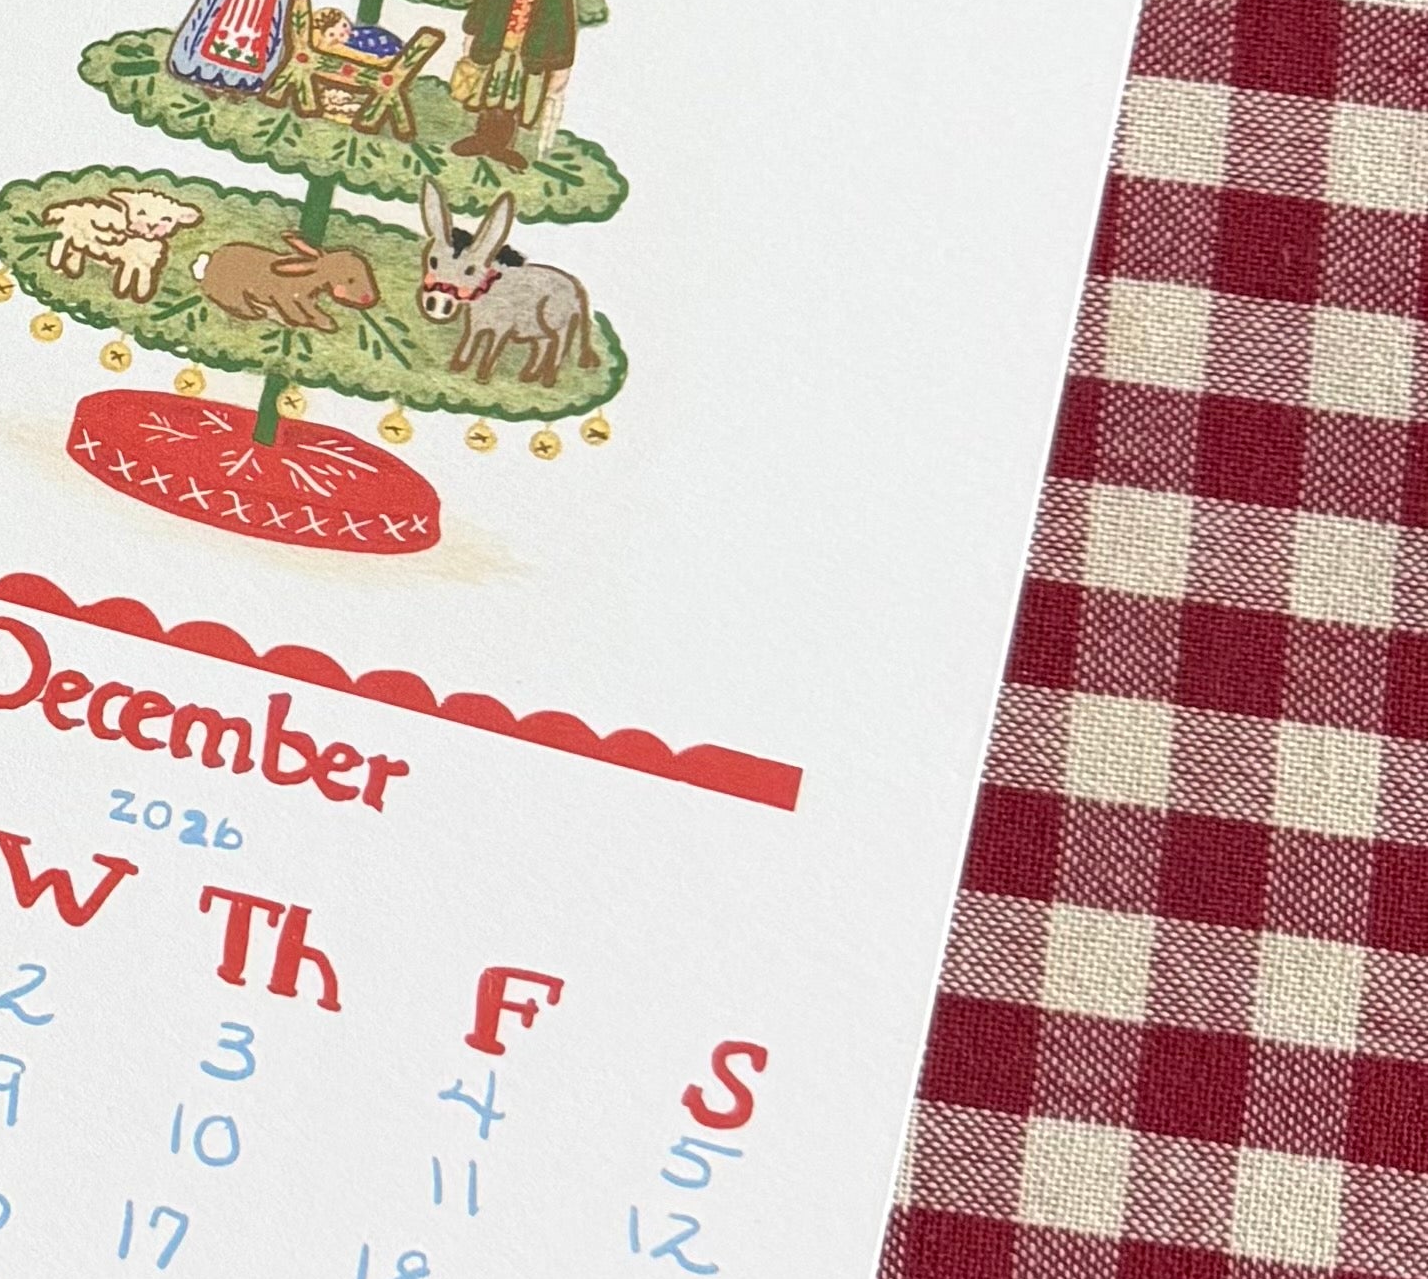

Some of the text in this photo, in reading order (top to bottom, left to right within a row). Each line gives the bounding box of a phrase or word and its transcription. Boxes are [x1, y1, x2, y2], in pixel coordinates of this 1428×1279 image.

[108, 788, 244, 851] 2026
[198, 884, 343, 1014] Th
[463, 965, 566, 1057] F
[680, 1039, 770, 1131] S
[170, 1102, 241, 1168] 10
[431, 1156, 480, 1218] 11
[628, 1205, 720, 1276] 12
[199, 1021, 257, 1082] 3
[437, 1070, 507, 1141] 4
[659, 1135, 744, 1191] 5
[117, 1199, 190, 1271] 17
